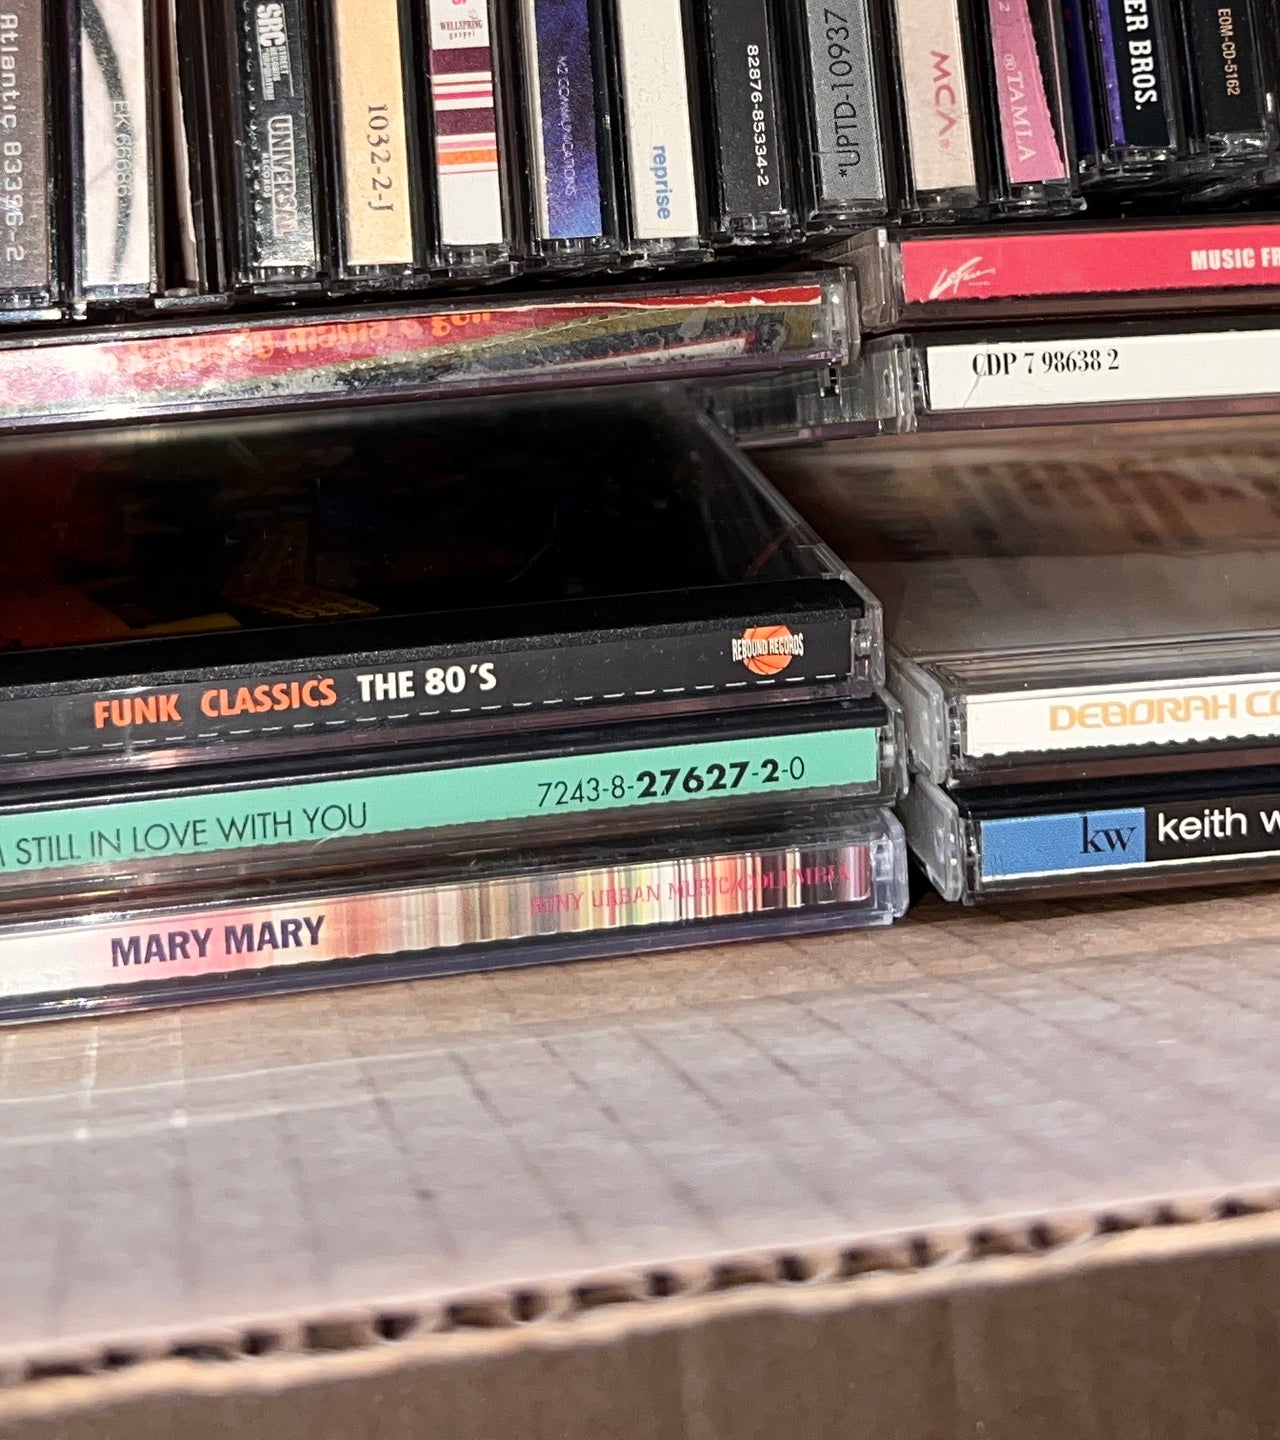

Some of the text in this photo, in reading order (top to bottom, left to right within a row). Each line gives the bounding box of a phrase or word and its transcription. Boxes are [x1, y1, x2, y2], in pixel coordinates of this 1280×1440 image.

[1127, 40, 1155, 110] BROS.
[1215, 9, 1240, 96] EOM-CD-5162
[746, 44, 769, 187] 82876-85334-2
[267, 118, 295, 234] UNIVERSAL
[364, 104, 392, 212] 1032-2-J
[650, 145, 673, 220] reprise
[1192, 250, 1255, 271] MUSIC
[1041, 350, 1102, 374] 98638
[732, 633, 804, 662] REBOUND RECORDS
[94, 693, 182, 728] FUNK
[201, 677, 337, 717] CLASSICS
[1049, 694, 1236, 731] DEBORAH
[538, 757, 805, 807] 7243-8-27627-2-0
[16, 837, 82, 865] STILL
[132, 823, 207, 852] LOVE
[1158, 809, 1247, 843] keith
[112, 915, 325, 967] MARY MARY
